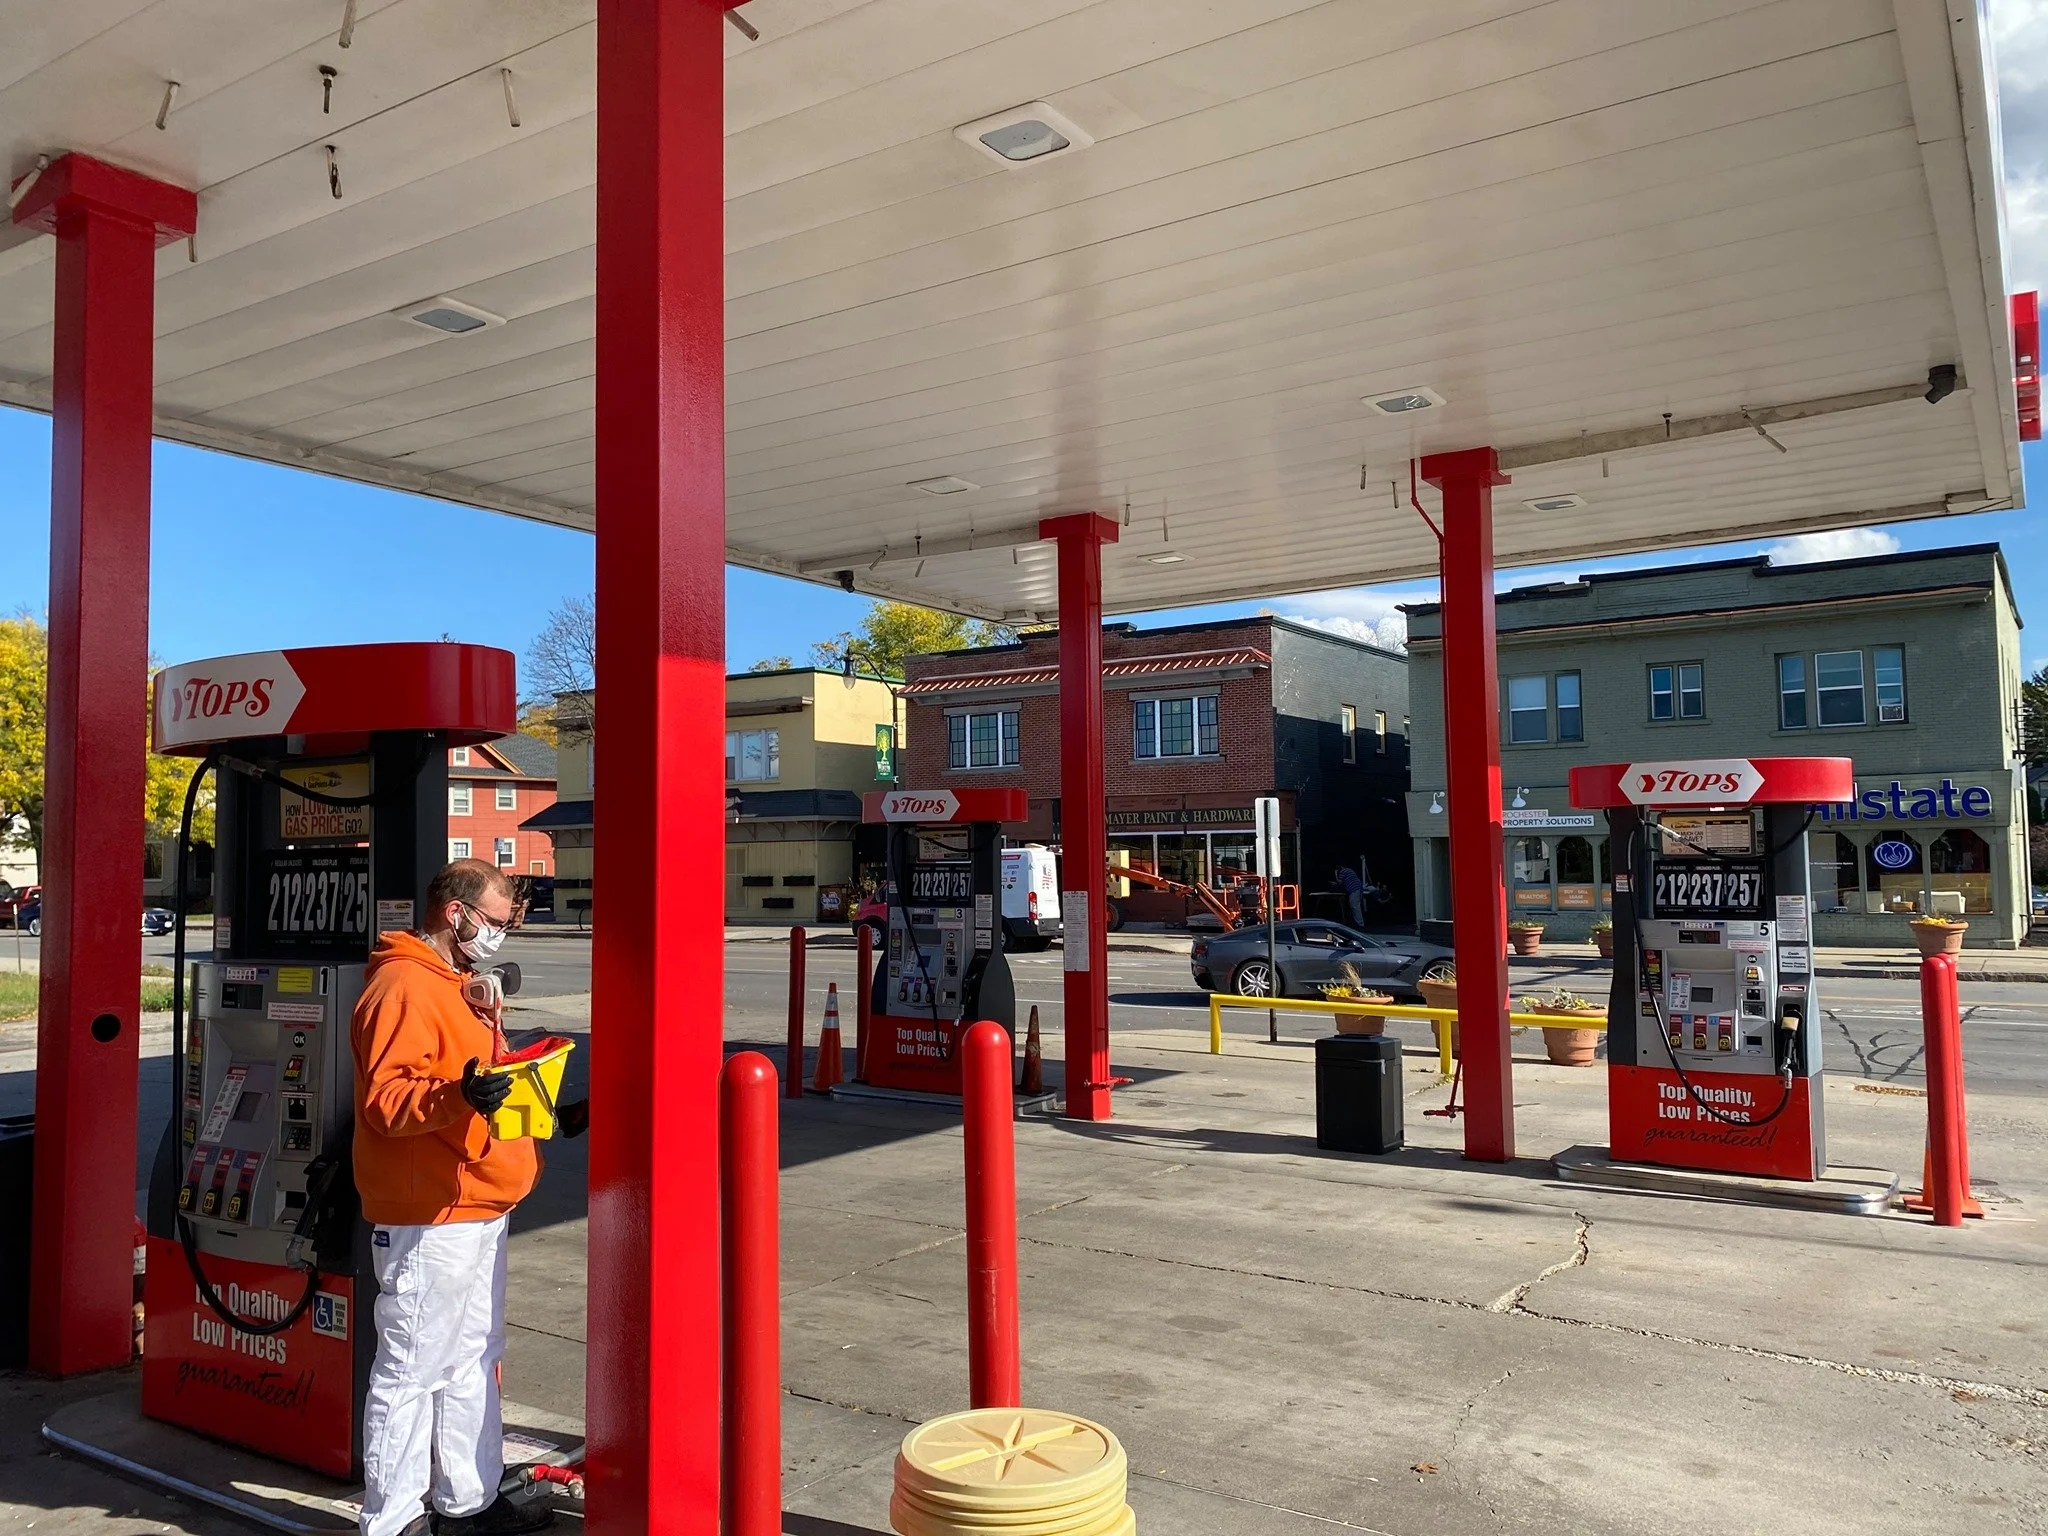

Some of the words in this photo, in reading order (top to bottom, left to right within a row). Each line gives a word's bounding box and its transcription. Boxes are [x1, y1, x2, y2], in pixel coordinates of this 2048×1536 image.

[184, 676, 274, 720] TOPS
[1658, 769, 1742, 793] TOPS
[285, 805, 301, 816] HOW
[900, 797, 947, 815] TOPS
[285, 817, 308, 836] GAS
[311, 815, 344, 835] PRICE
[344, 818, 363, 834] GO?
[1104, 812, 1140, 825] MAYER
[1143, 811, 1175, 825] PAINT
[1180, 811, 1189, 823] &
[1503, 818, 1543, 827] PROPERTY
[1546, 817, 1592, 826] SOLUTIONS
[912, 872, 931, 897] 212
[932, 872, 951, 897] 237
[952, 872, 971, 897] 257
[1655, 873, 1688, 906] 212
[1691, 873, 1722, 906] 237
[1727, 873, 1761, 907] 257
[268, 872, 302, 931] 212
[303, 870, 340, 932] 237
[955, 908, 963, 919] 3
[1759, 922, 1769, 936] 5
[320, 967, 329, 995] 1
[294, 1036, 305, 1044] OK
[897, 1027, 913, 1041] Top
[915, 1028, 950, 1044] Qualty,
[896, 1042, 915, 1055] Low
[1658, 1082, 1687, 1101] Top
[1693, 1084, 1756, 1108] Quality,
[1658, 1102, 1691, 1120] Low
[1696, 1105, 1751, 1124] Prices
[1642, 1125, 1779, 1151] guaranteed!
[193, 1311, 225, 1348] Low
[231, 1327, 287, 1365] Prices
[175, 1359, 316, 1413] guaranteed!
